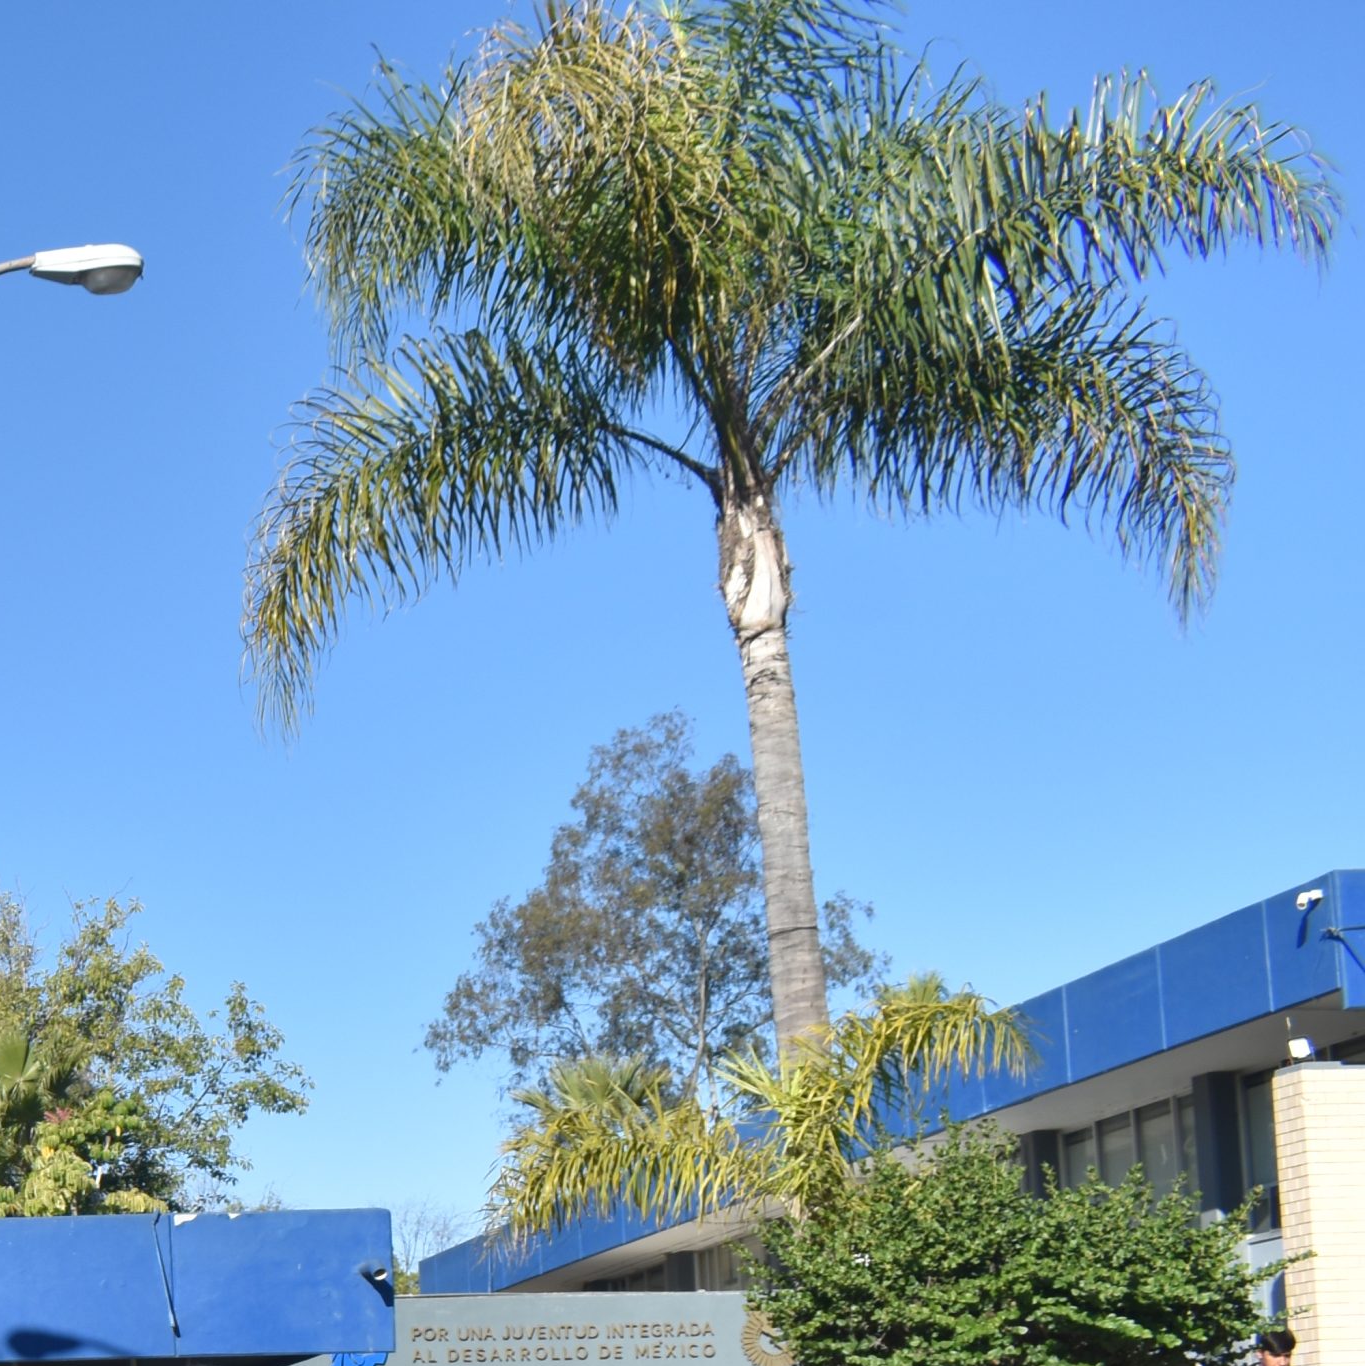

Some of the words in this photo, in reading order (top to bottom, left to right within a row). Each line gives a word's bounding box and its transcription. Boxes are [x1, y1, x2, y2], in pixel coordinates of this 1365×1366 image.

[411, 1326, 449, 1342] POR
[457, 1326, 496, 1342] UNA
[502, 1324, 600, 1341] JUVENTUD
[606, 1322, 715, 1340] INTEGRADA
[413, 1348, 437, 1364] AL
[448, 1345, 589, 1364] DESARROLLO
[599, 1345, 624, 1361] DE
[635, 1341, 717, 1360] MÉXICO
